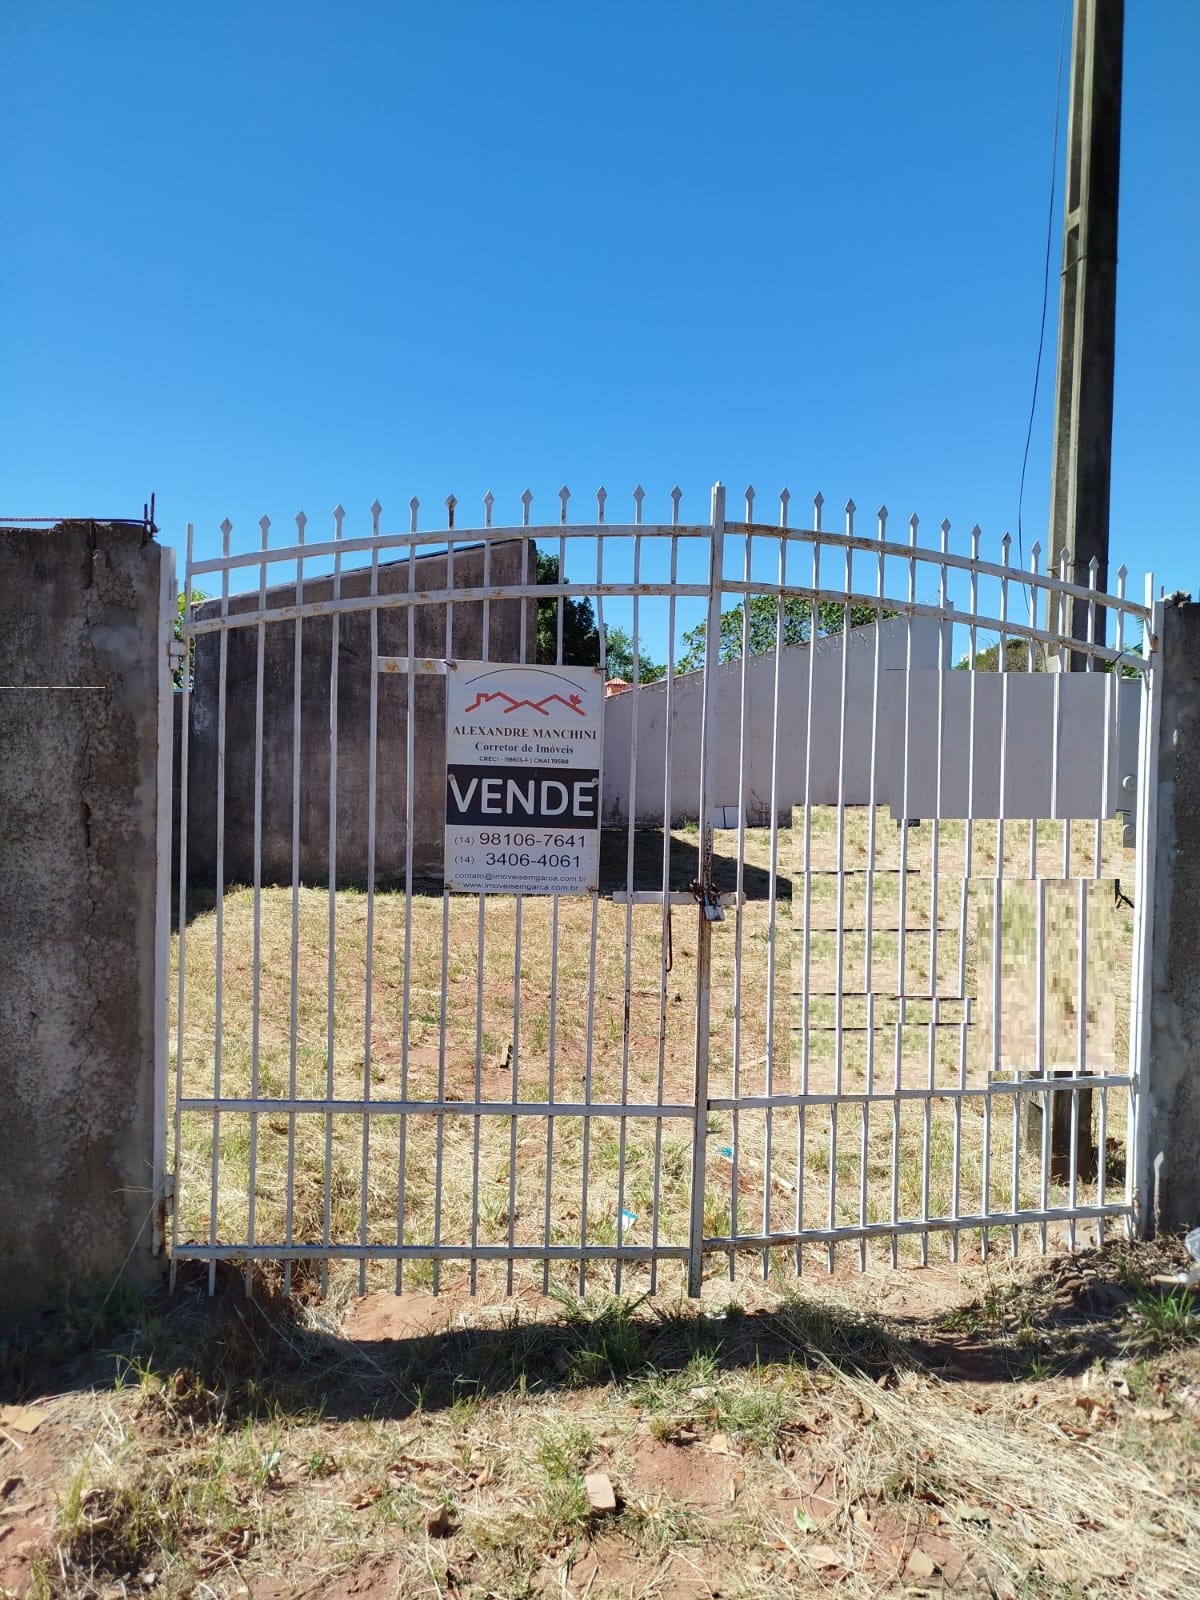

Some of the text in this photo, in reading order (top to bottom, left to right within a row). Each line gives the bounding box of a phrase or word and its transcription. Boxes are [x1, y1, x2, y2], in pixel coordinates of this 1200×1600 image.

[452, 726, 597, 740] ALEXANDRE MANCHINI
[475, 741, 574, 754] Corretor de Imóveis
[449, 778, 596, 817] VENDE
[454, 832, 586, 848] (14) 98106-7641
[454, 852, 580, 868] (14) 3406-4061
[454, 872, 587, 883] contato@imoveisemgarca.com.br
[463, 882, 579, 892] www.imoveisemgarca.com.br
